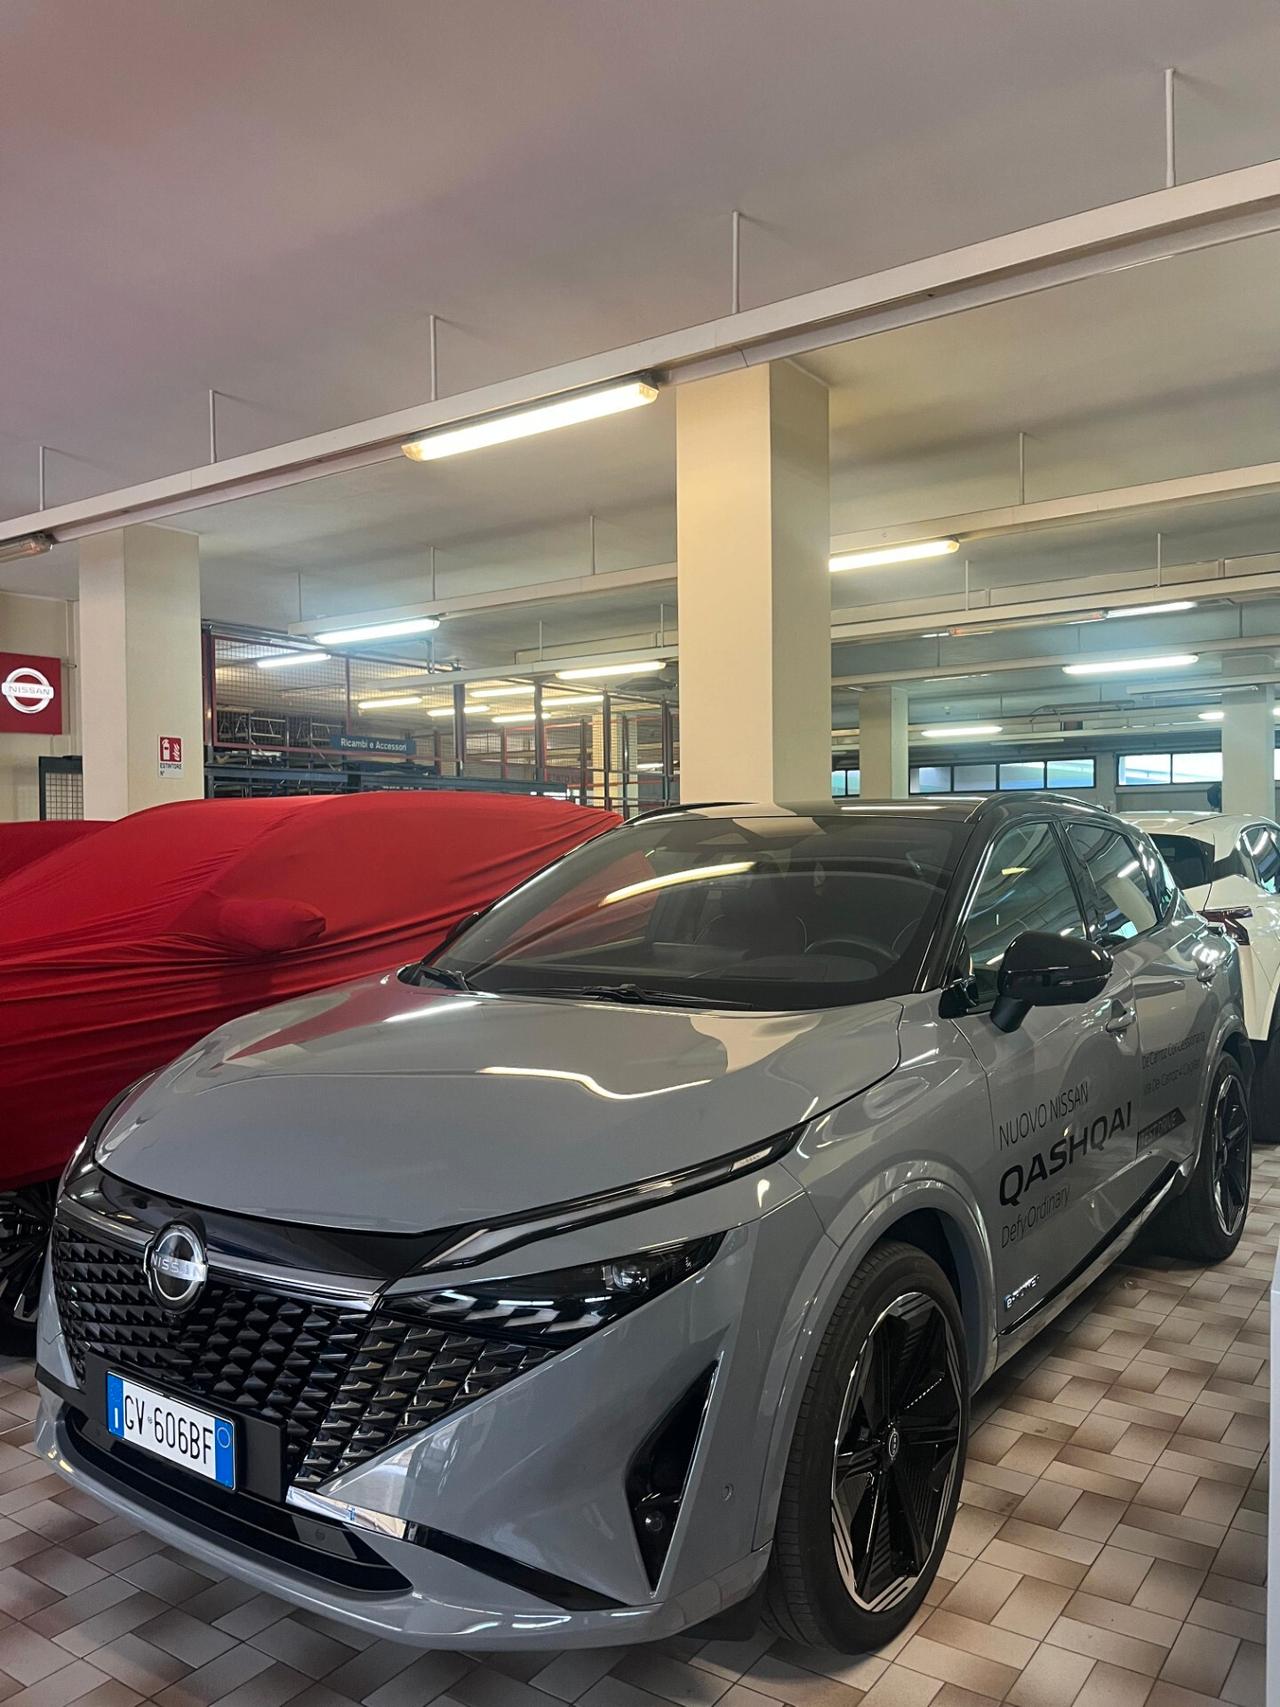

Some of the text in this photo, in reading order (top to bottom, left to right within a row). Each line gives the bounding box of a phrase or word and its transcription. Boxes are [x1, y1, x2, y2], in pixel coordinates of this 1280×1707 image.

[9, 685, 51, 696] NISSAN
[340, 737, 368, 749] Ricambi
[375, 741, 407, 751] Accessori
[1000, 1081, 1089, 1151] NUOVO NISSAN
[1000, 1101, 1132, 1206] QASHQAI
[1001, 1186, 1071, 1248] Defy Ordinary
[151, 1251, 204, 1280] NISSAN
[124, 1394, 214, 1465] GV 606BF
